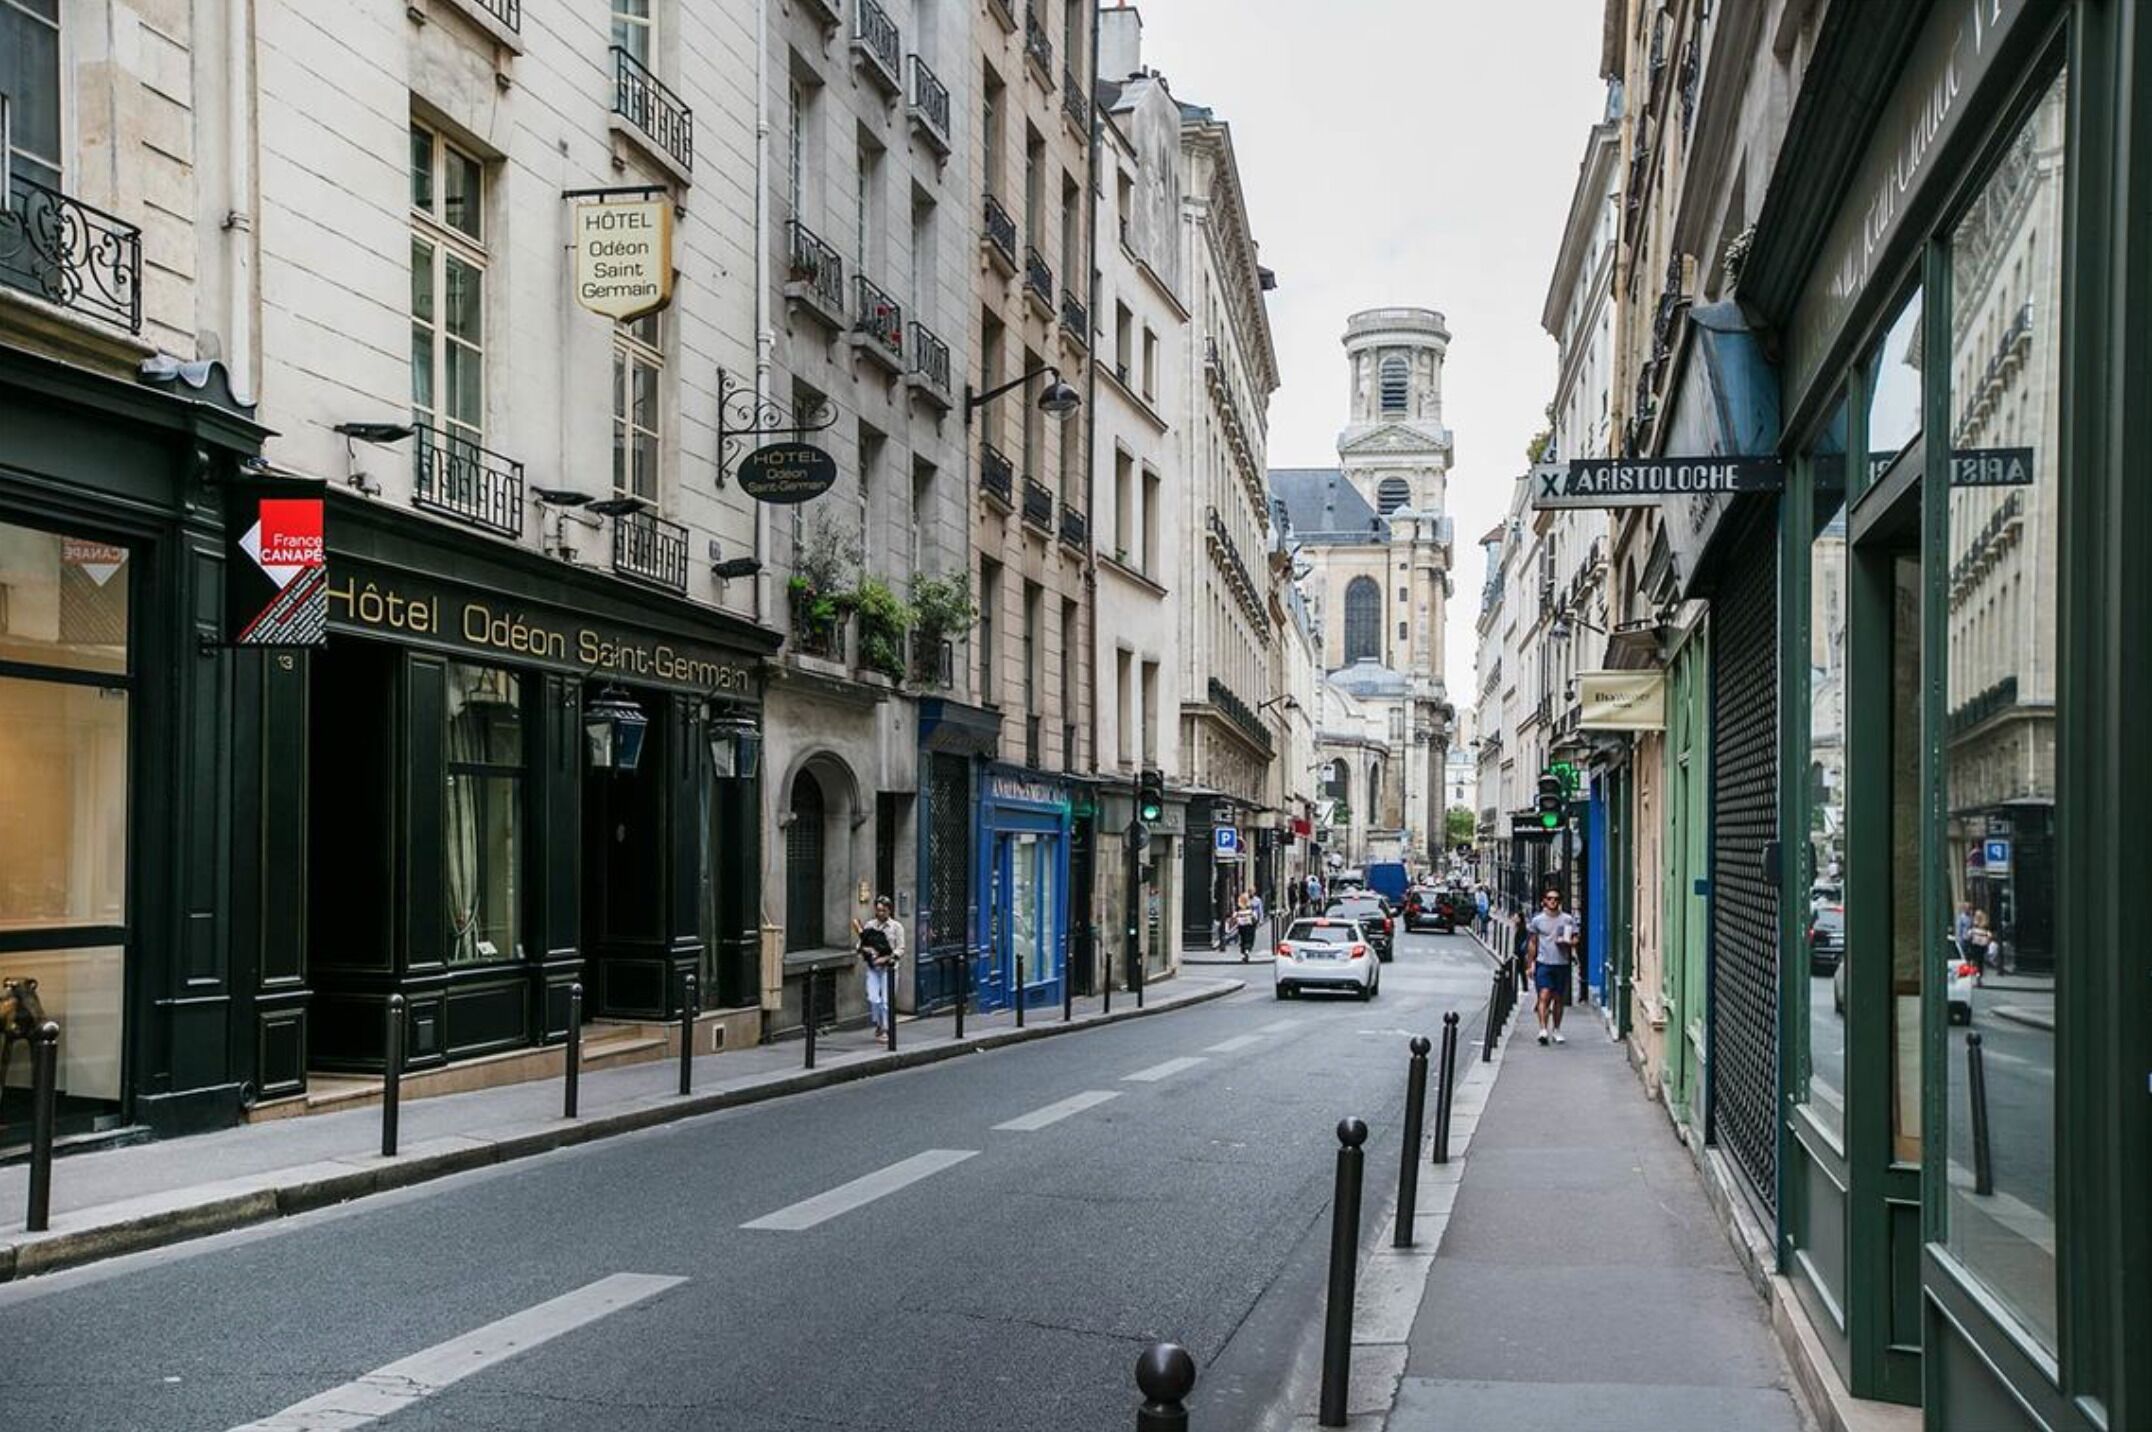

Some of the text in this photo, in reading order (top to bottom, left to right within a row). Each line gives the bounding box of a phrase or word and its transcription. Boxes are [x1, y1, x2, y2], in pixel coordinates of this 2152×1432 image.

[585, 210, 653, 231] HÔTEL
[589, 240, 649, 257] Odéon
[593, 261, 644, 279] Saint
[581, 280, 657, 299] Germain
[272, 533, 323, 548] France
[326, 574, 439, 634] Hôtel
[462, 604, 565, 659] Odéon
[577, 629, 750, 692] Saint-Germain
[277, 655, 294, 671] 13
[1220, 831, 1232, 845] P
